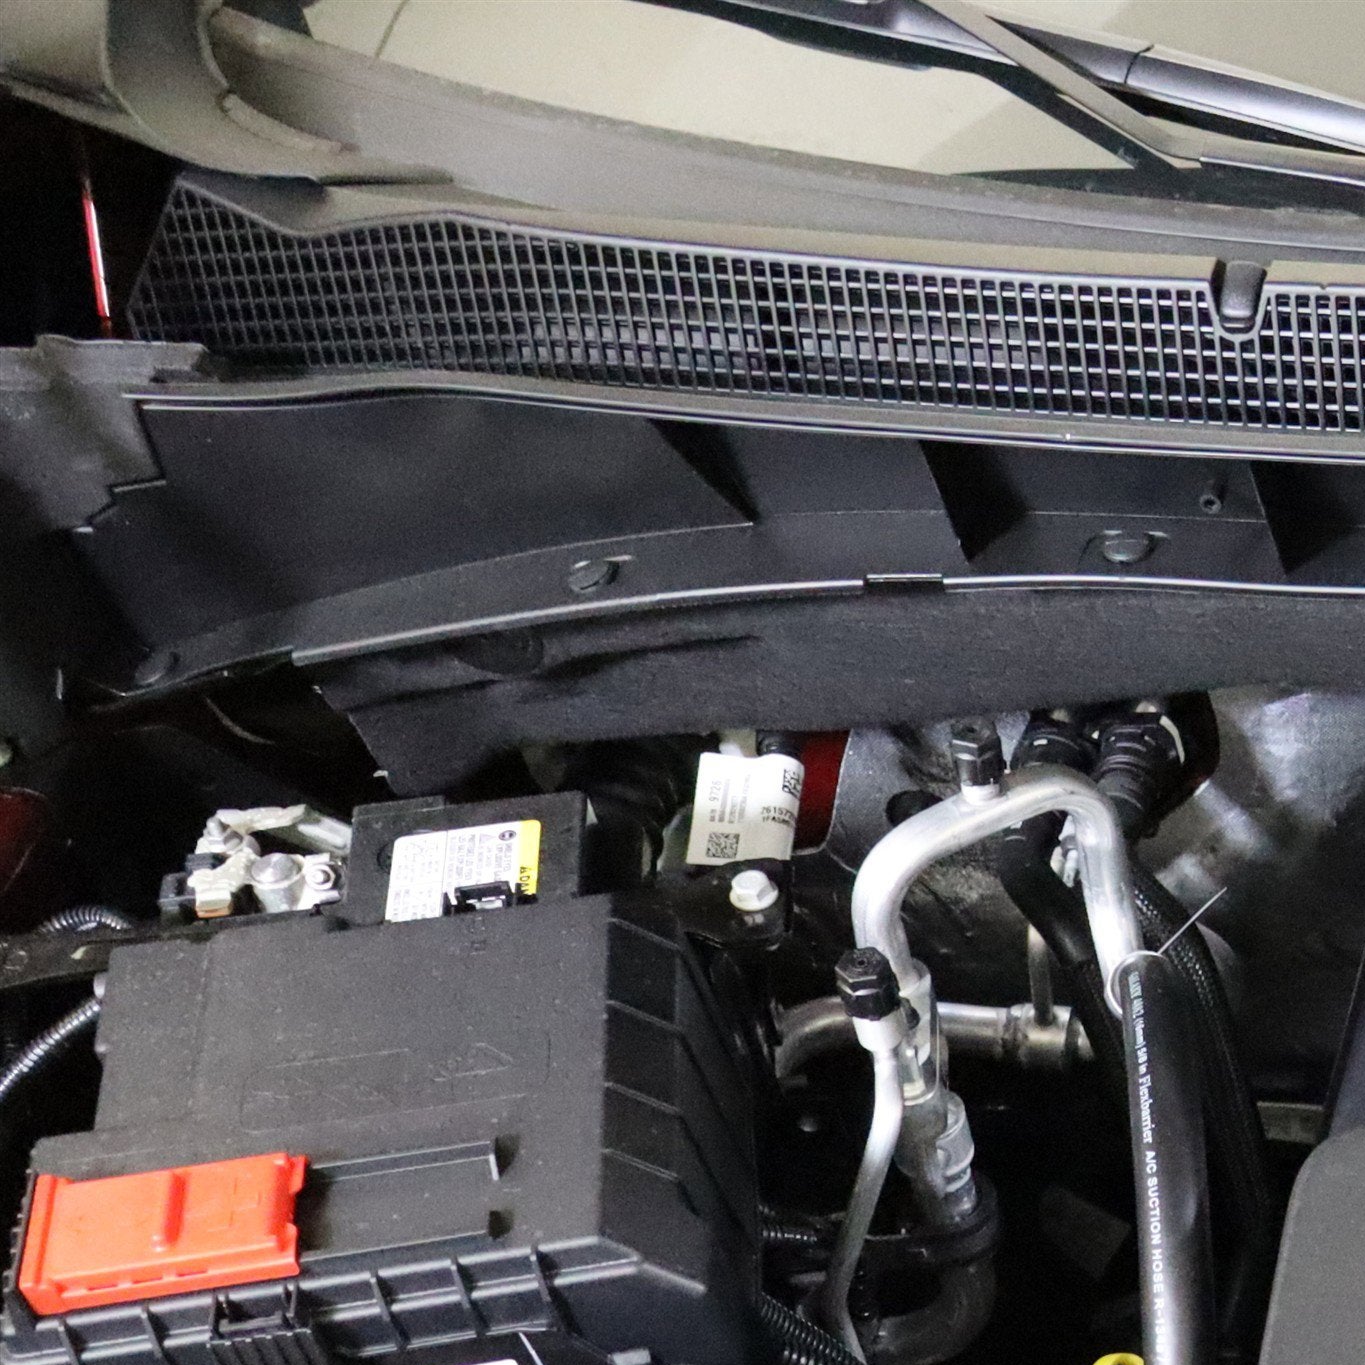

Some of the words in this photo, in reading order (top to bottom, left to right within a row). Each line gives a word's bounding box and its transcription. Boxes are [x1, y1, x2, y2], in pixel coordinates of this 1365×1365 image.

[1139, 1074, 1156, 1144] Flexbarrier
[1146, 1176, 1162, 1244] SUCTION
[1151, 1248, 1164, 1292] HOSE
